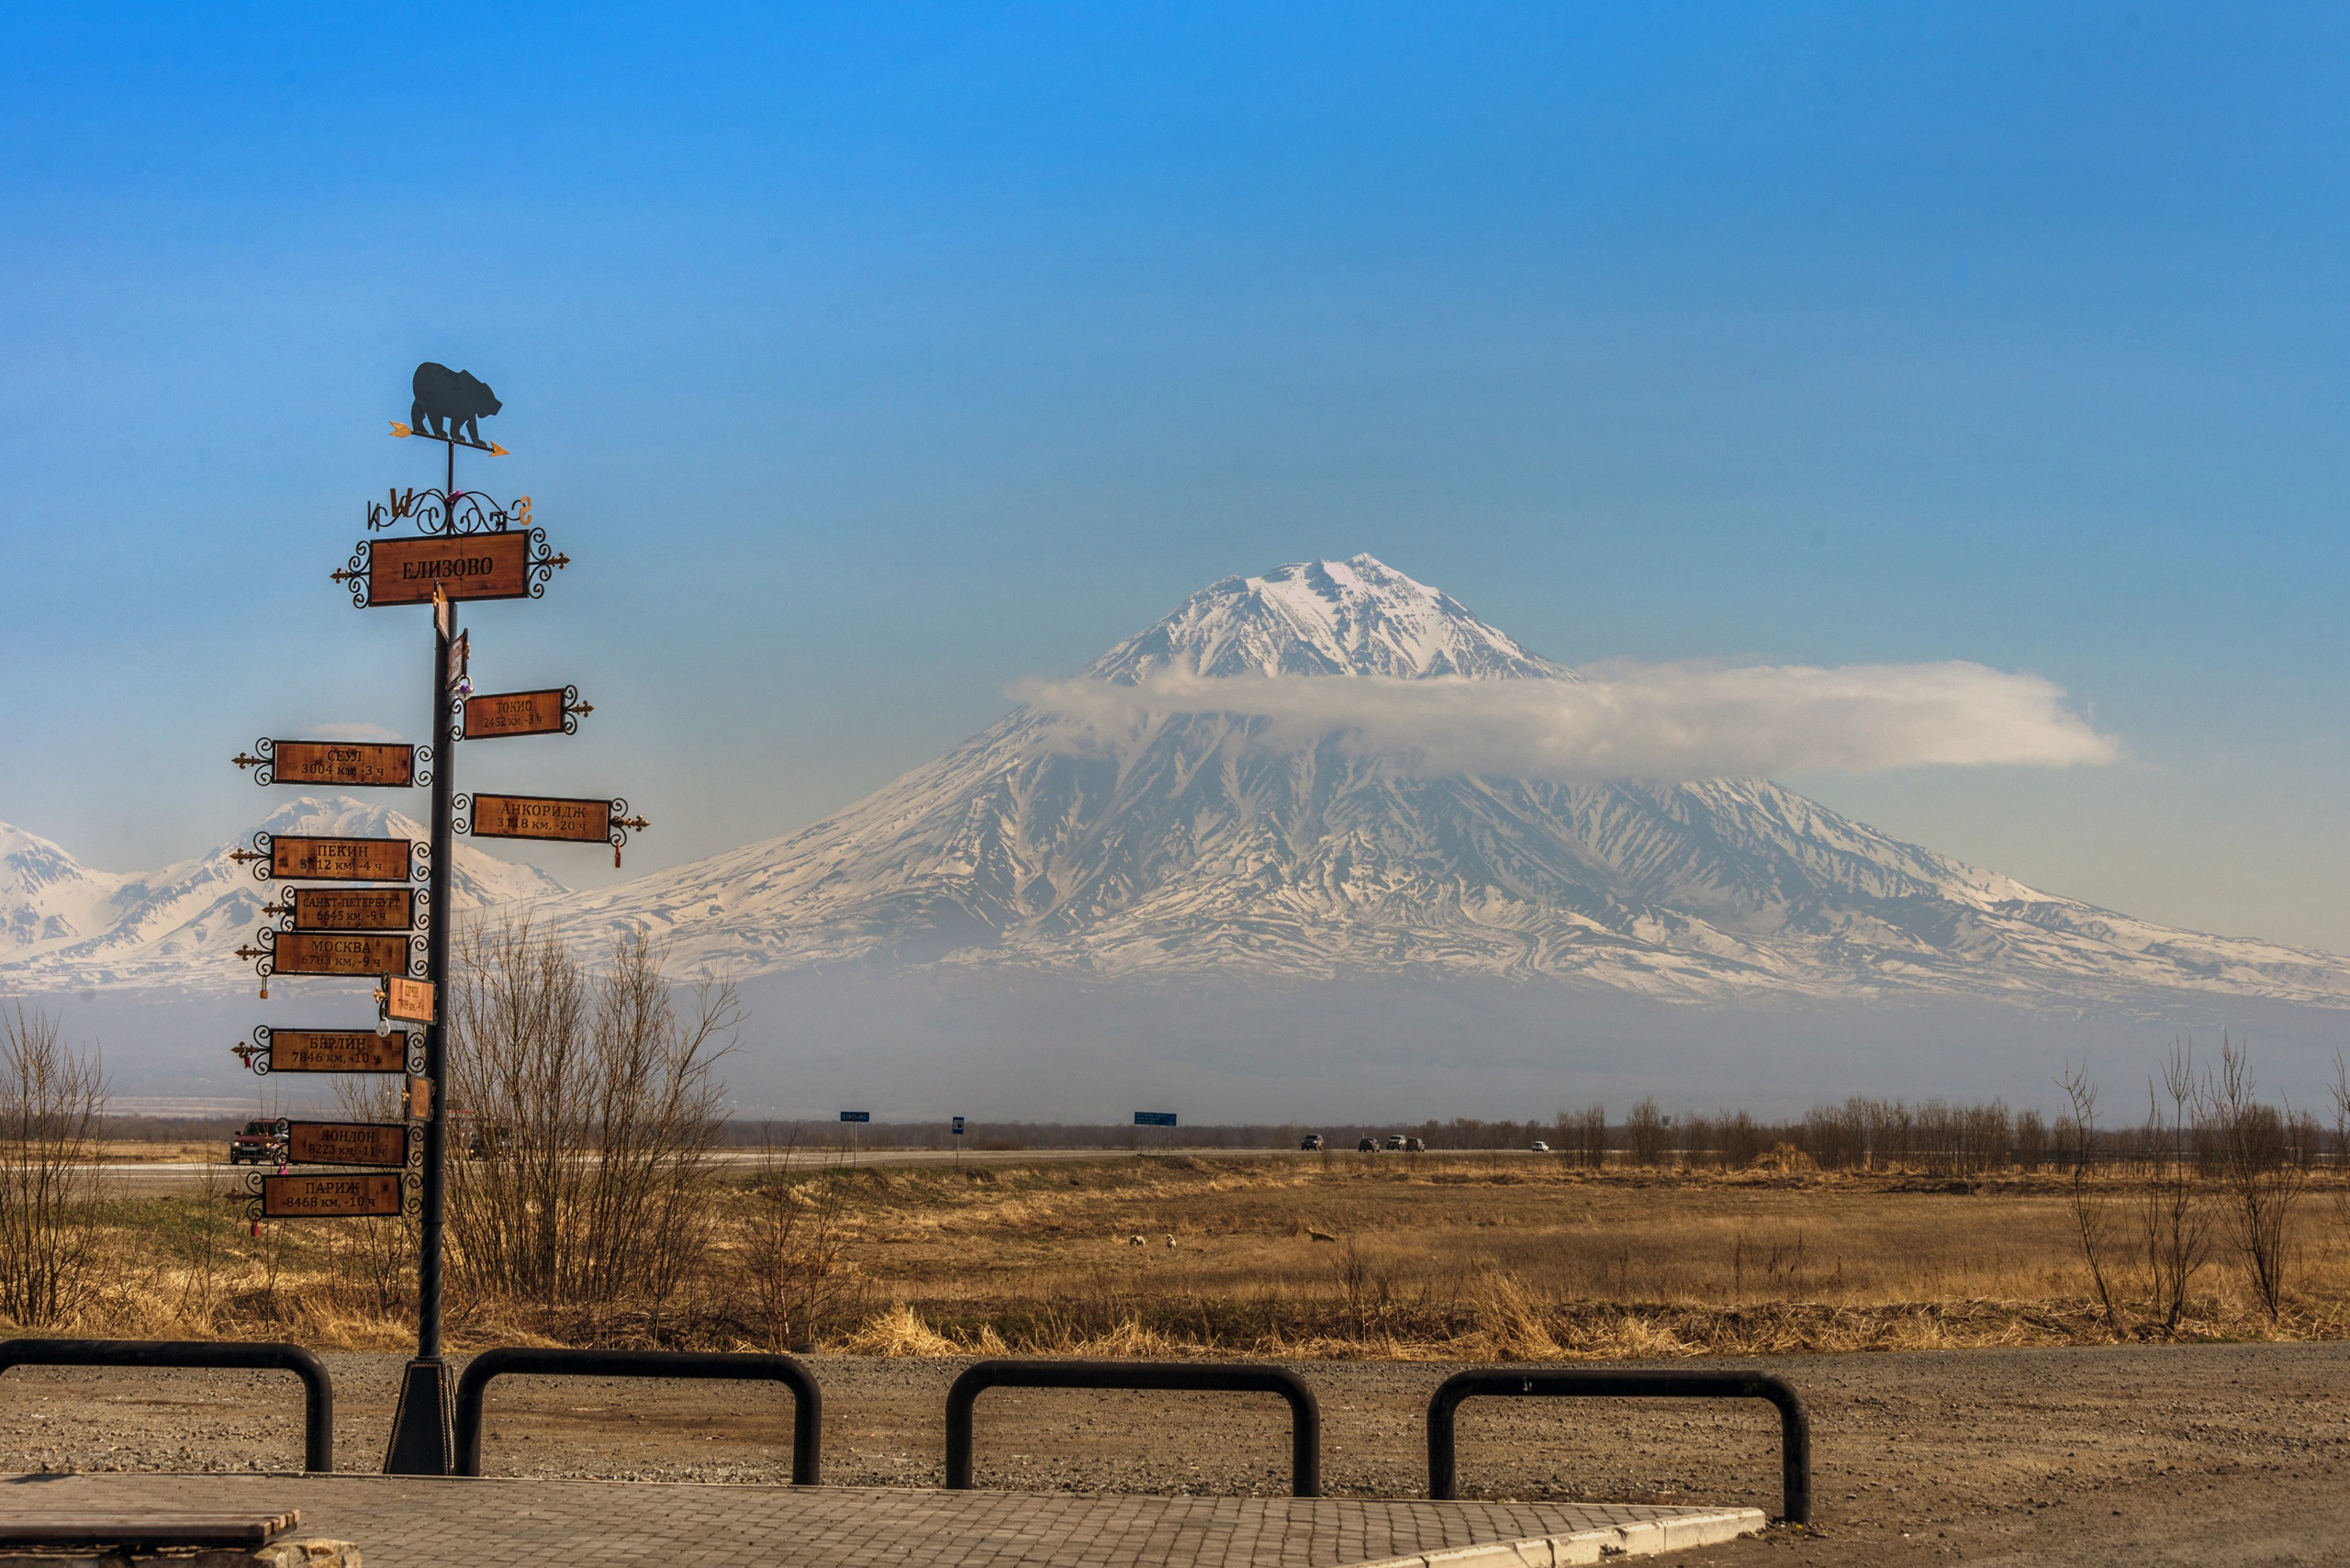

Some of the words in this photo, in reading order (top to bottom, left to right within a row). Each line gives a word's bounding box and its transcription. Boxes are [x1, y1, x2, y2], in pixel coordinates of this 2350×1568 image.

[402, 556, 494, 580] ЕЛИЗОВО
[496, 700, 532, 713] ТОКИО
[484, 716, 506, 728] 2452
[509, 717, 523, 726] км,
[327, 750, 362, 762] СЕУЛ
[301, 764, 333, 774] 3004
[361, 766, 373, 776] -3
[500, 803, 587, 819] АНКОРИДЖ
[497, 817, 529, 829] 3118
[532, 822, 552, 832] км,
[555, 821, 575, 831] -20
[317, 845, 368, 857] ПЕКИН
[335, 863, 356, 872] км,
[359, 861, 371, 870] -4
[375, 863, 382, 871] ч
[303, 898, 400, 908] САНКТ-ПЕТЕРБУРГ
[317, 911, 343, 921] 6645
[346, 913, 364, 922] км,
[366, 911, 377, 921] -9
[311, 940, 372, 954] МОСКВА
[301, 955, 331, 966] 6783
[335, 958, 355, 968] км,
[358, 957, 370, 967] -9
[373, 958, 381, 967] ч
[292, 1051, 323, 1062] 7846
[326, 1055, 346, 1064] км,
[350, 1053, 369, 1063] -10
[319, 1130, 375, 1143] ЛОНДОН
[308, 1144, 335, 1154] 8223
[358, 1146, 375, 1156] -11
[378, 1148, 385, 1157] ч
[305, 1182, 360, 1194] ПАРИЖ
[285, 1196, 318, 1207] 8468
[321, 1200, 341, 1209] км,
[344, 1196, 364, 1207] -10
[368, 1198, 376, 1206] ч
